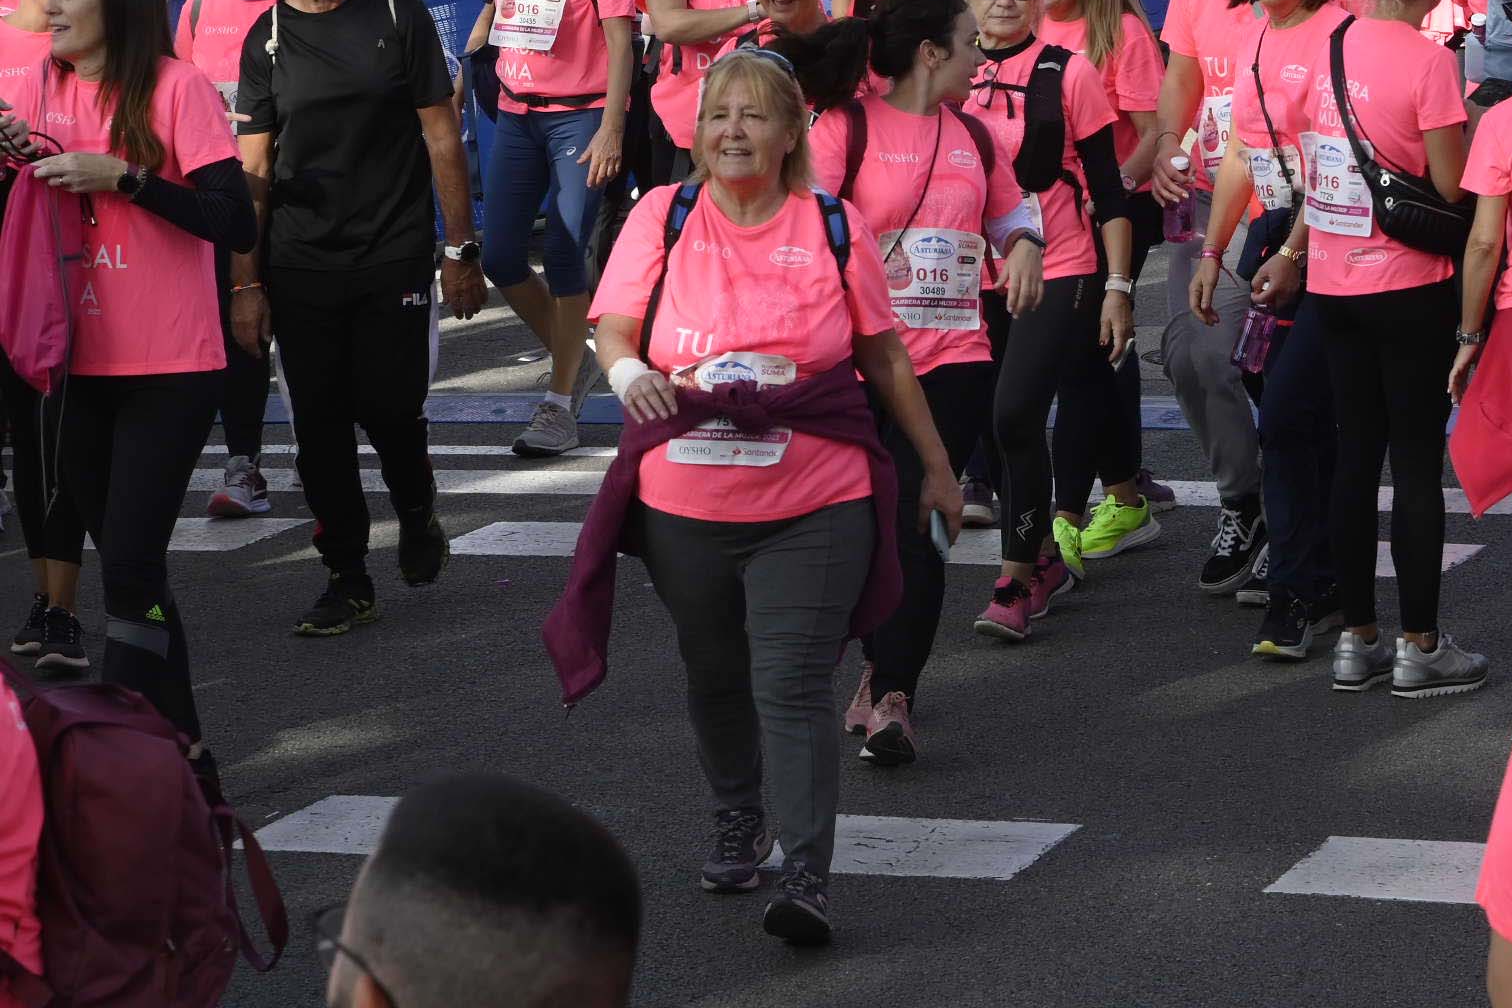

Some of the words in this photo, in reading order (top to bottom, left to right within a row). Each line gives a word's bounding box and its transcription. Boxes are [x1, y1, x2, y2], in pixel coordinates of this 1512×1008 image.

[517, 3, 539, 16] 016
[1204, 56, 1229, 78] TU
[914, 246, 953, 257] ASTURIANA
[916, 267, 949, 282] 016
[919, 286, 946, 296] 30489
[676, 327, 714, 357] TU
[761, 368, 786, 377] SUMA
[712, 431, 722, 440] DE
[723, 431, 733, 440] LA
[679, 446, 711, 457] OYSHO
